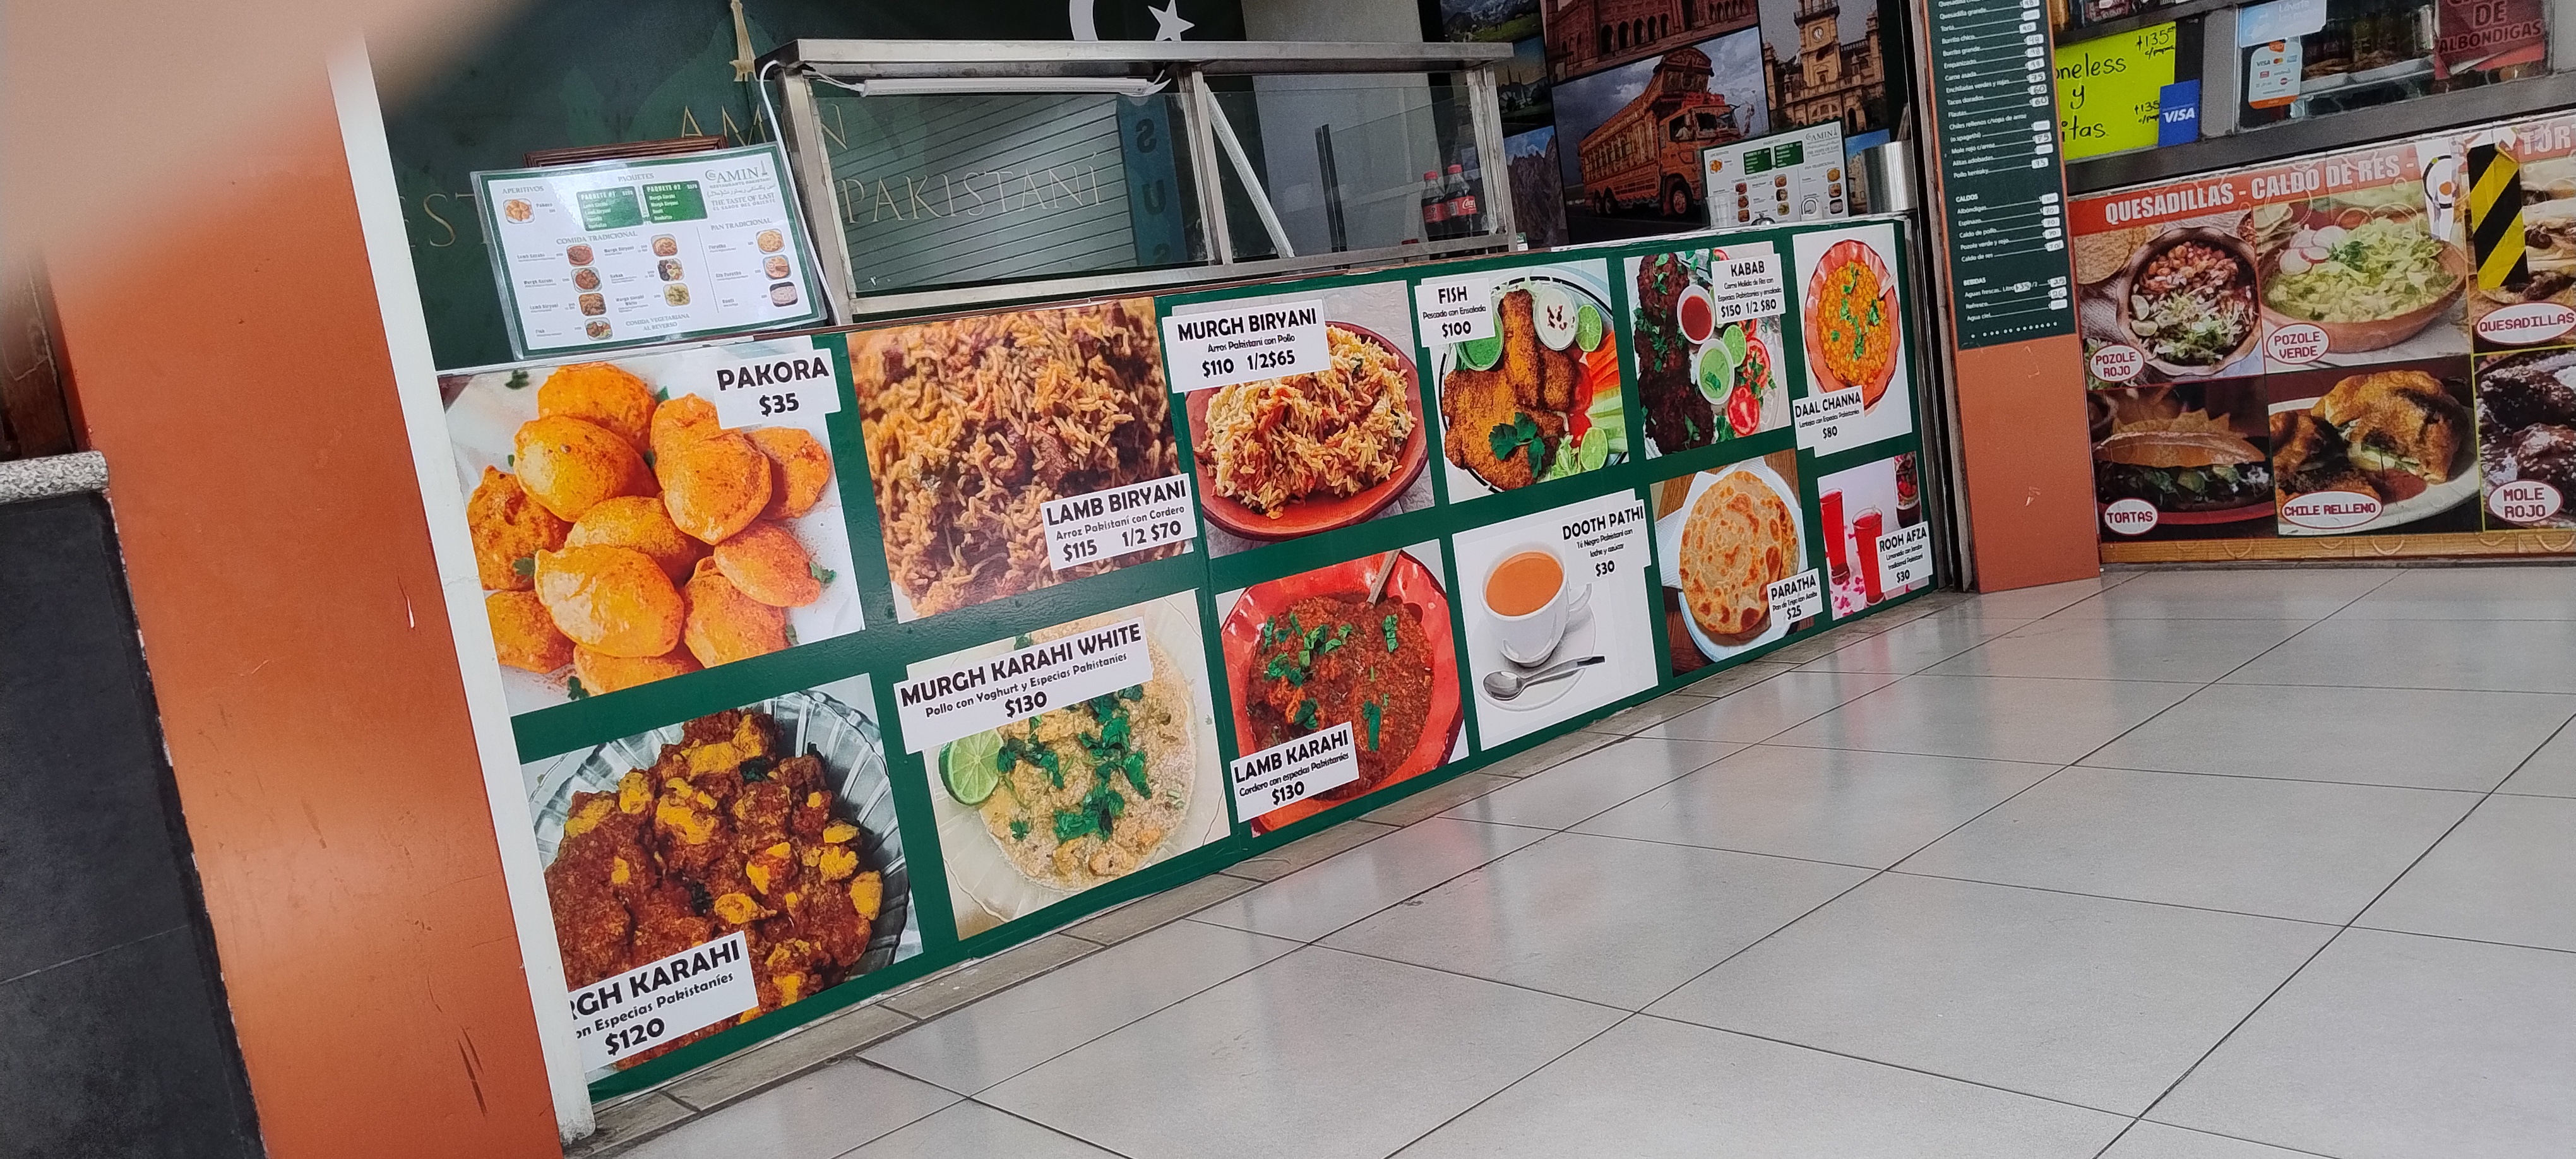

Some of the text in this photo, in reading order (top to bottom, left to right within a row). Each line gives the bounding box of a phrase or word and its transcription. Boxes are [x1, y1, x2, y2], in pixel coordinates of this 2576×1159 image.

[2474, 1, 2508, 27] DE
[2438, 20, 2542, 53] ALBONDIGAS
[2070, 85, 2084, 110] y
[2162, 107, 2195, 123] VISA
[2523, 124, 2576, 155] TOR
[617, 173, 655, 182] PAQUETES
[502, 186, 544, 194] APERITIVOS
[580, 191, 607, 201] PAQUETE
[725, 196, 746, 205] TASTE
[758, 192, 774, 200] EAST
[2105, 183, 2234, 224] QUESADILLAS
[2251, 167, 2320, 200] CALDO
[2326, 162, 2353, 186] DE
[725, 218, 772, 229] TRADICIONAL
[556, 231, 638, 245] COMIDA TRADICIONAL
[1730, 260, 1765, 277] KABAB
[1438, 285, 1468, 304] FISH
[1459, 304, 1486, 315] Ensalada
[1720, 299, 1777, 318] $150 1/2 $80
[626, 318, 650, 326] COMIDA
[652, 321, 678, 330] REVERSO
[1177, 307, 1317, 342] MURGH BIRYANI
[1441, 321, 1471, 339] $100
[2479, 312, 2575, 332] QUESADILLAS
[2274, 331, 2321, 346] POZOLE
[2096, 352, 2136, 366] POZOLE
[2279, 345, 2318, 359] VERDE
[717, 357, 830, 391] PAKORA
[1202, 358, 1234, 378] $110
[2103, 365, 2131, 378] ROJO
[759, 393, 799, 417] $35
[1795, 391, 1861, 418] DAAL CHANNA
[1822, 425, 1838, 440] $80
[1046, 480, 1186, 526] LAMB BIRYANI
[2503, 487, 2545, 501] MOLE
[2106, 511, 2154, 524] TORTAS
[2284, 502, 2376, 516] CHILE RELLENO
[2504, 504, 2546, 518] ROJO
[1056, 528, 1082, 541] Arroz
[1131, 514, 1148, 524] con
[1149, 506, 1184, 520] Cordero
[1562, 506, 1644, 540] DOOTH PATHI
[1063, 520, 1182, 562] $115 1/2 $70
[1879, 526, 1927, 553] ROOH AFZA
[1595, 560, 1615, 577] $30
[1896, 569, 1910, 583] $30
[1770, 574, 1816, 601] PARATHA
[1786, 605, 1802, 620] $25
[900, 623, 1142, 708] MURGH KARAHI WHITE
[925, 702, 953, 718] Pollo
[957, 697, 974, 710] con
[976, 683, 1019, 703] Yoghurt
[1022, 682, 1028, 692] y
[1030, 669, 1071, 687] Especias
[1004, 691, 1048, 719] $130
[1234, 729, 1349, 783] LAMB KARAHI
[1239, 781, 1268, 797] Cordero
[1269, 776, 1281, 787] con
[1272, 781, 1305, 805] $130
[629, 939, 741, 999] KARAHI
[595, 1002, 653, 1031] Especias
[656, 972, 734, 1008] Pakistaníes
[605, 1017, 665, 1056] $120
